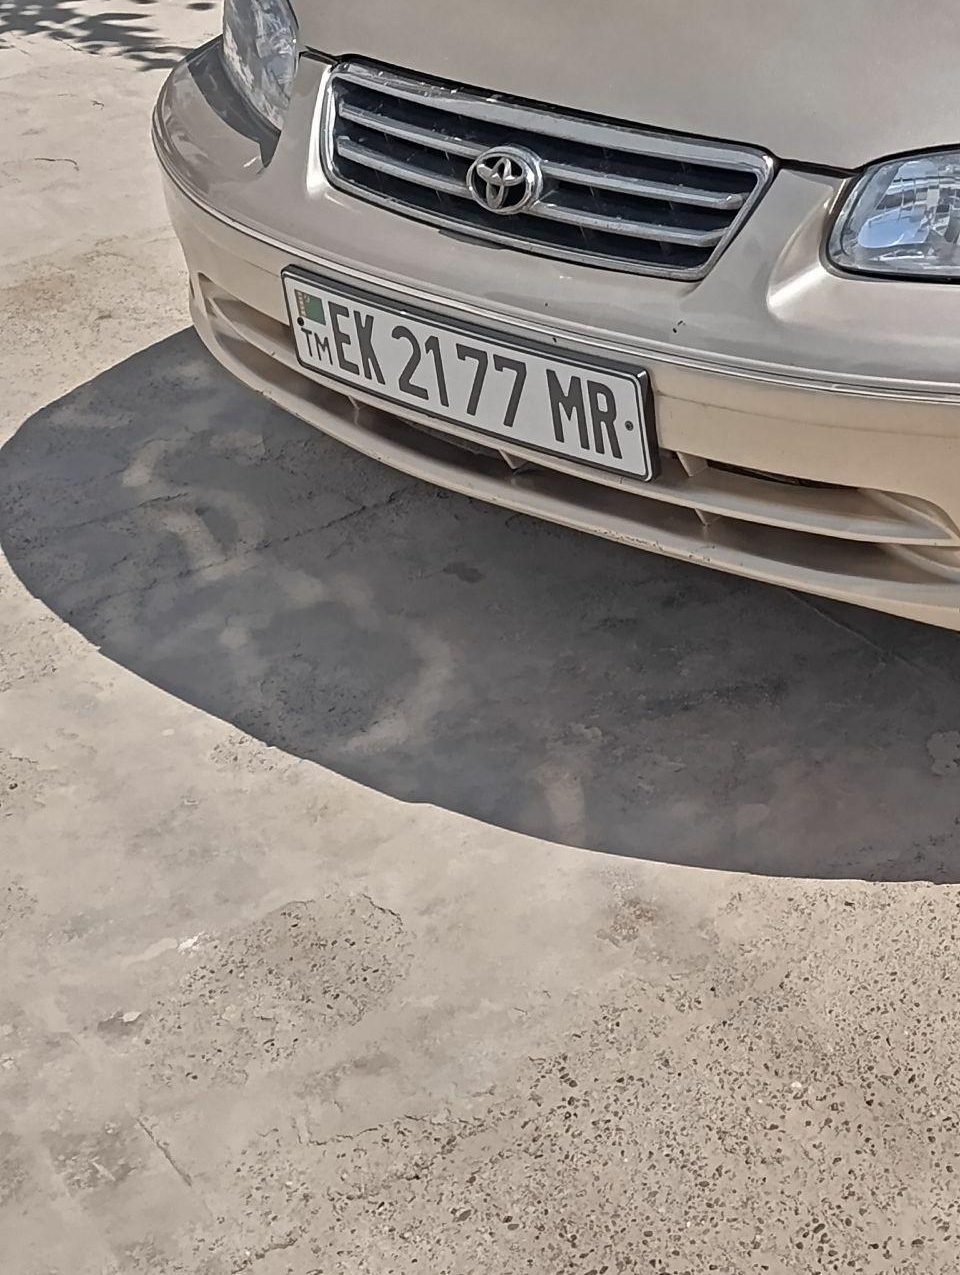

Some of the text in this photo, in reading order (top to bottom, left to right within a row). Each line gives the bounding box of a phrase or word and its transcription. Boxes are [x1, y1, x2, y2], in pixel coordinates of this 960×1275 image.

[301, 327, 333, 365] TM
[328, 301, 622, 459] EK 2177 MR
